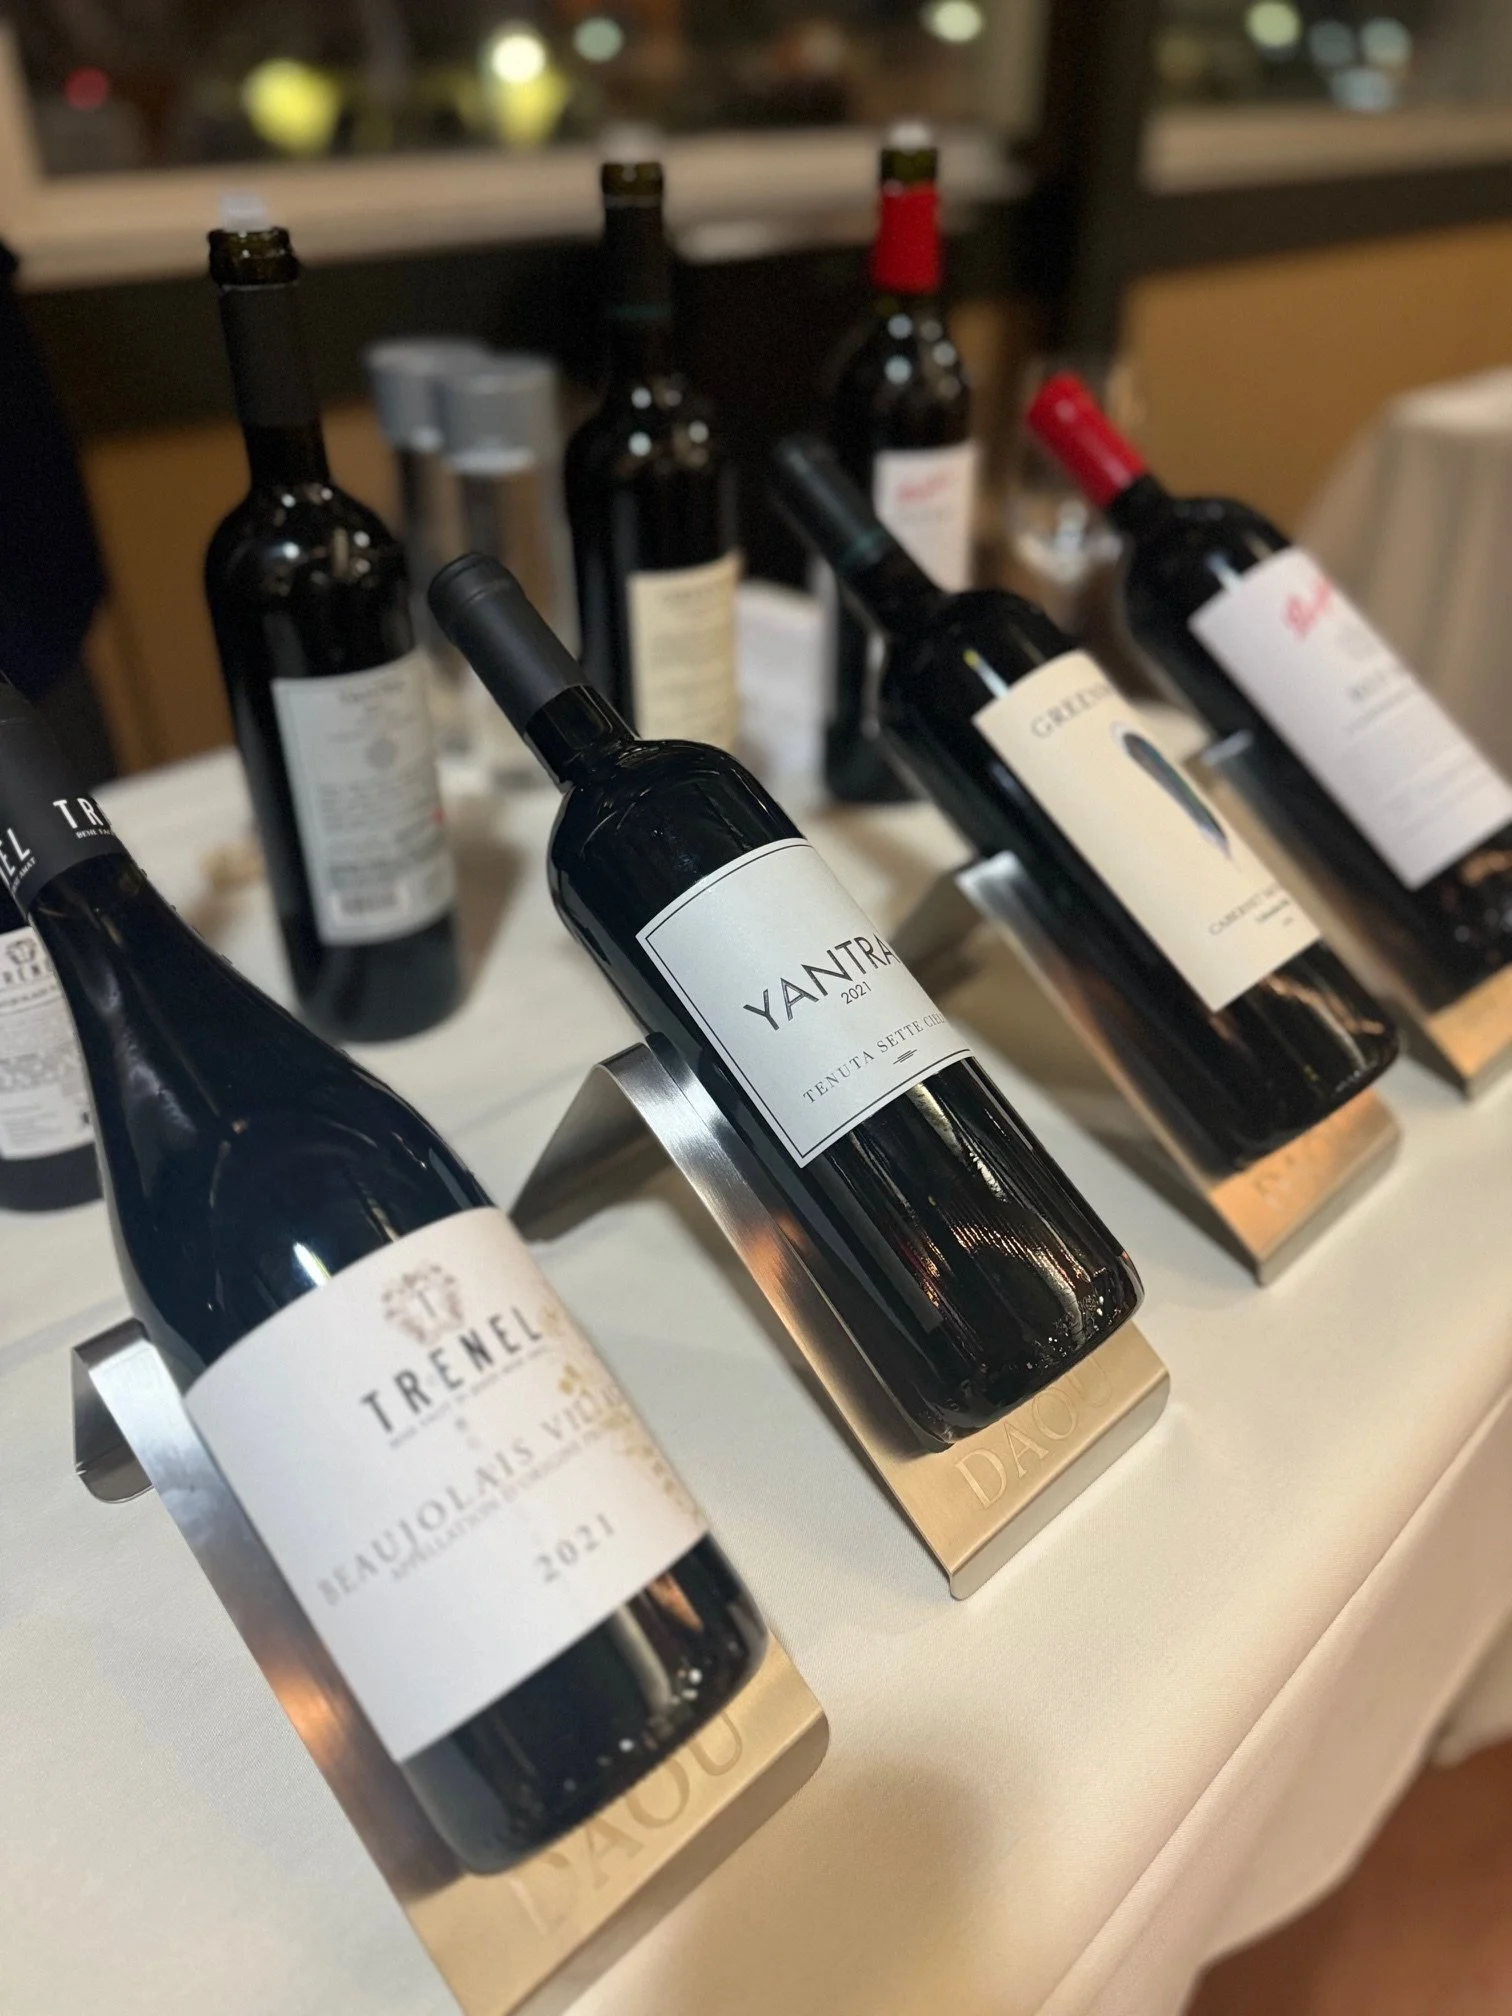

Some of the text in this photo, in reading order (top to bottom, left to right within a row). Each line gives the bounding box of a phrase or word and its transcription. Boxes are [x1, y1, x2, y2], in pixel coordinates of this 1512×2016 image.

[743, 933, 901, 1031] YANTRA
[840, 981, 872, 1005] 2021
[802, 1050, 875, 1104] TENUTA
[876, 1020, 924, 1054] SETTE
[360, 1305, 542, 1435] TRENEL
[954, 1356, 1112, 1510] DAOU
[316, 1436, 536, 1606] BEAUJOLAIS
[535, 1512, 615, 1583] 2021
[508, 1712, 743, 1937] DAOU
